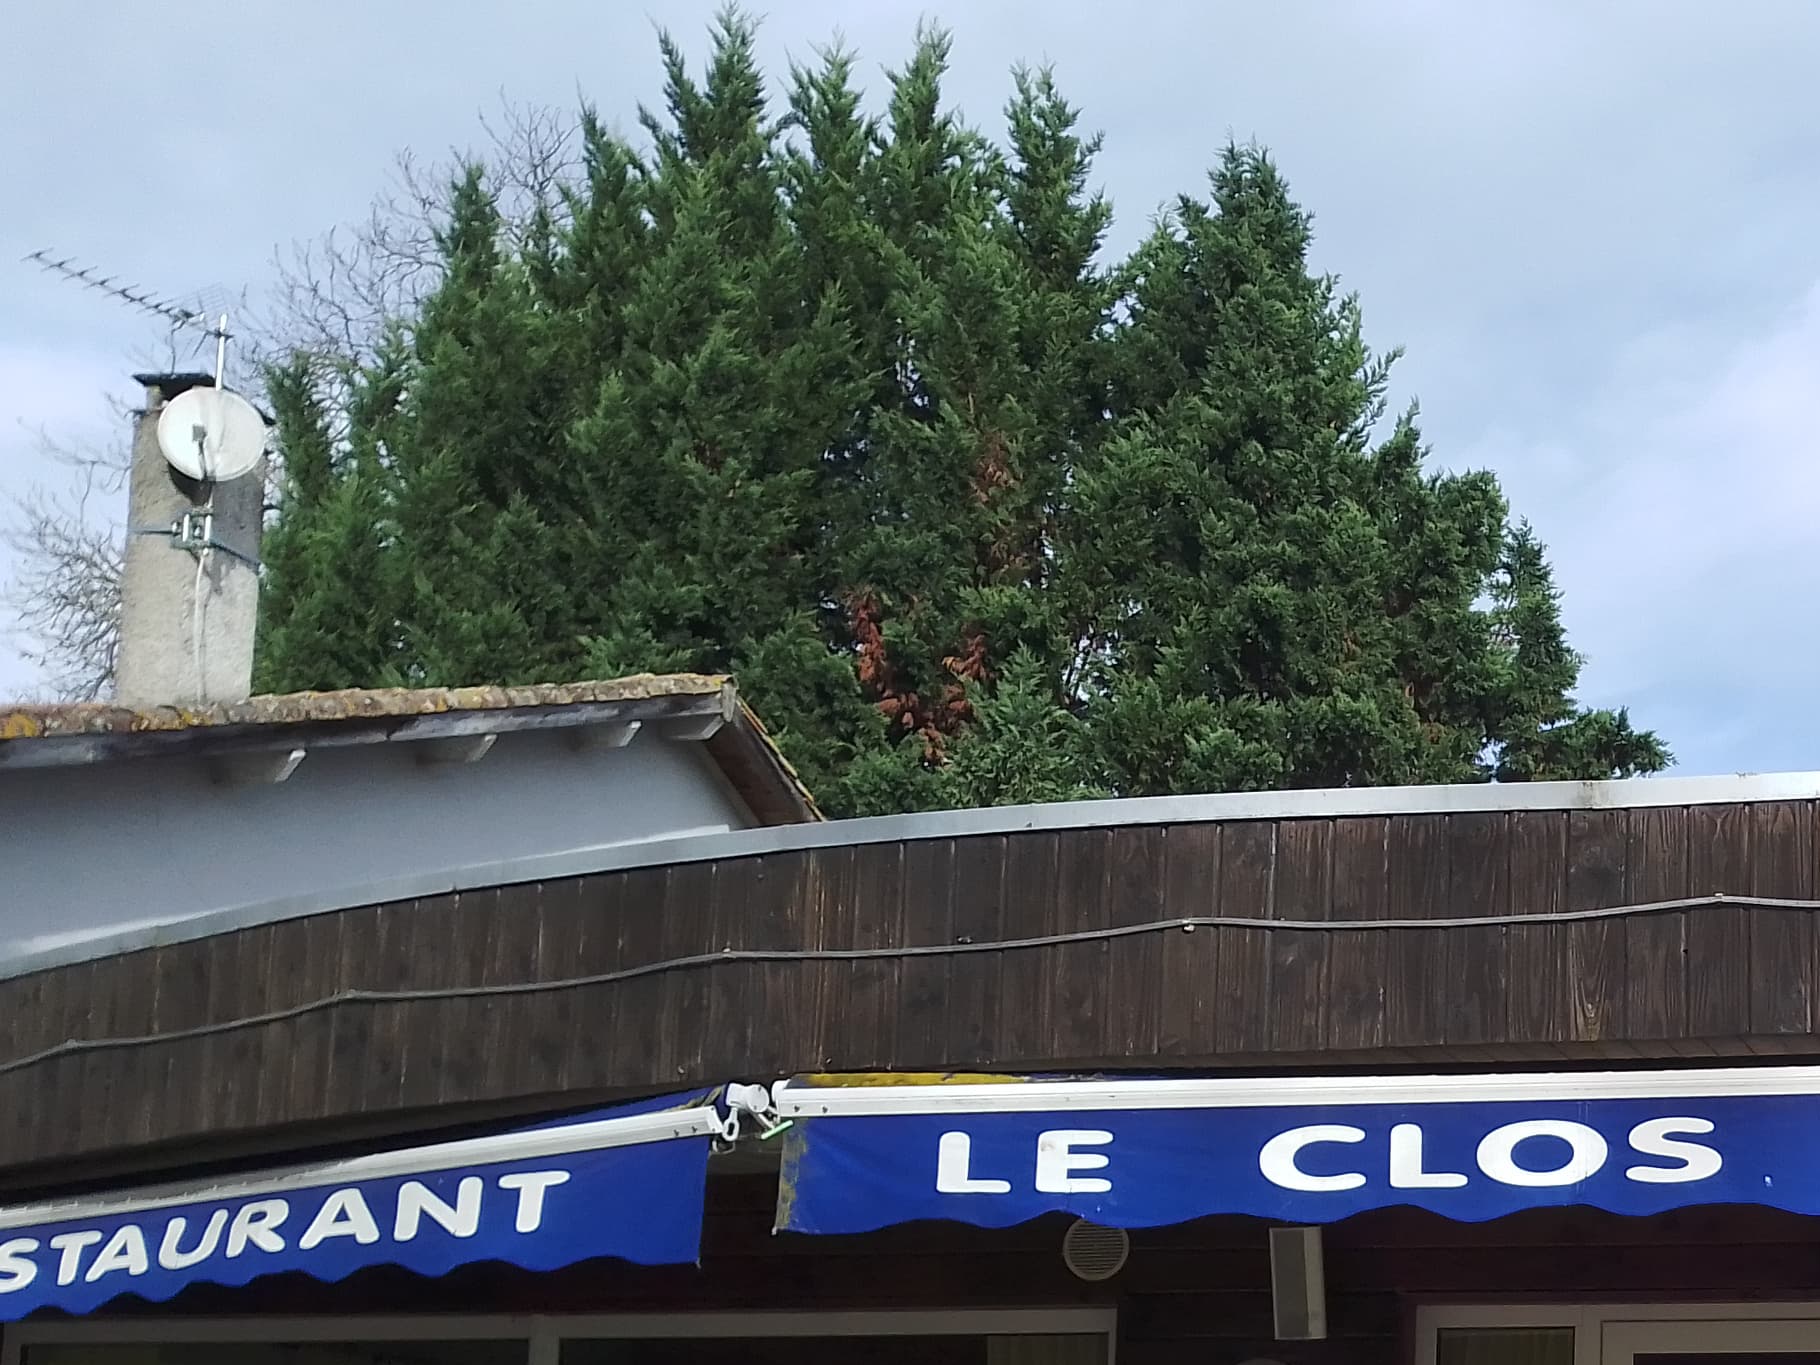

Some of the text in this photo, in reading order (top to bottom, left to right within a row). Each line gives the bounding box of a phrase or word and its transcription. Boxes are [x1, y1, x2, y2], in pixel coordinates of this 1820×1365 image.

[936, 1129, 1114, 1194] LE
[1259, 1116, 1723, 1192] CLOS
[0, 1170, 570, 1294] STAURANT
